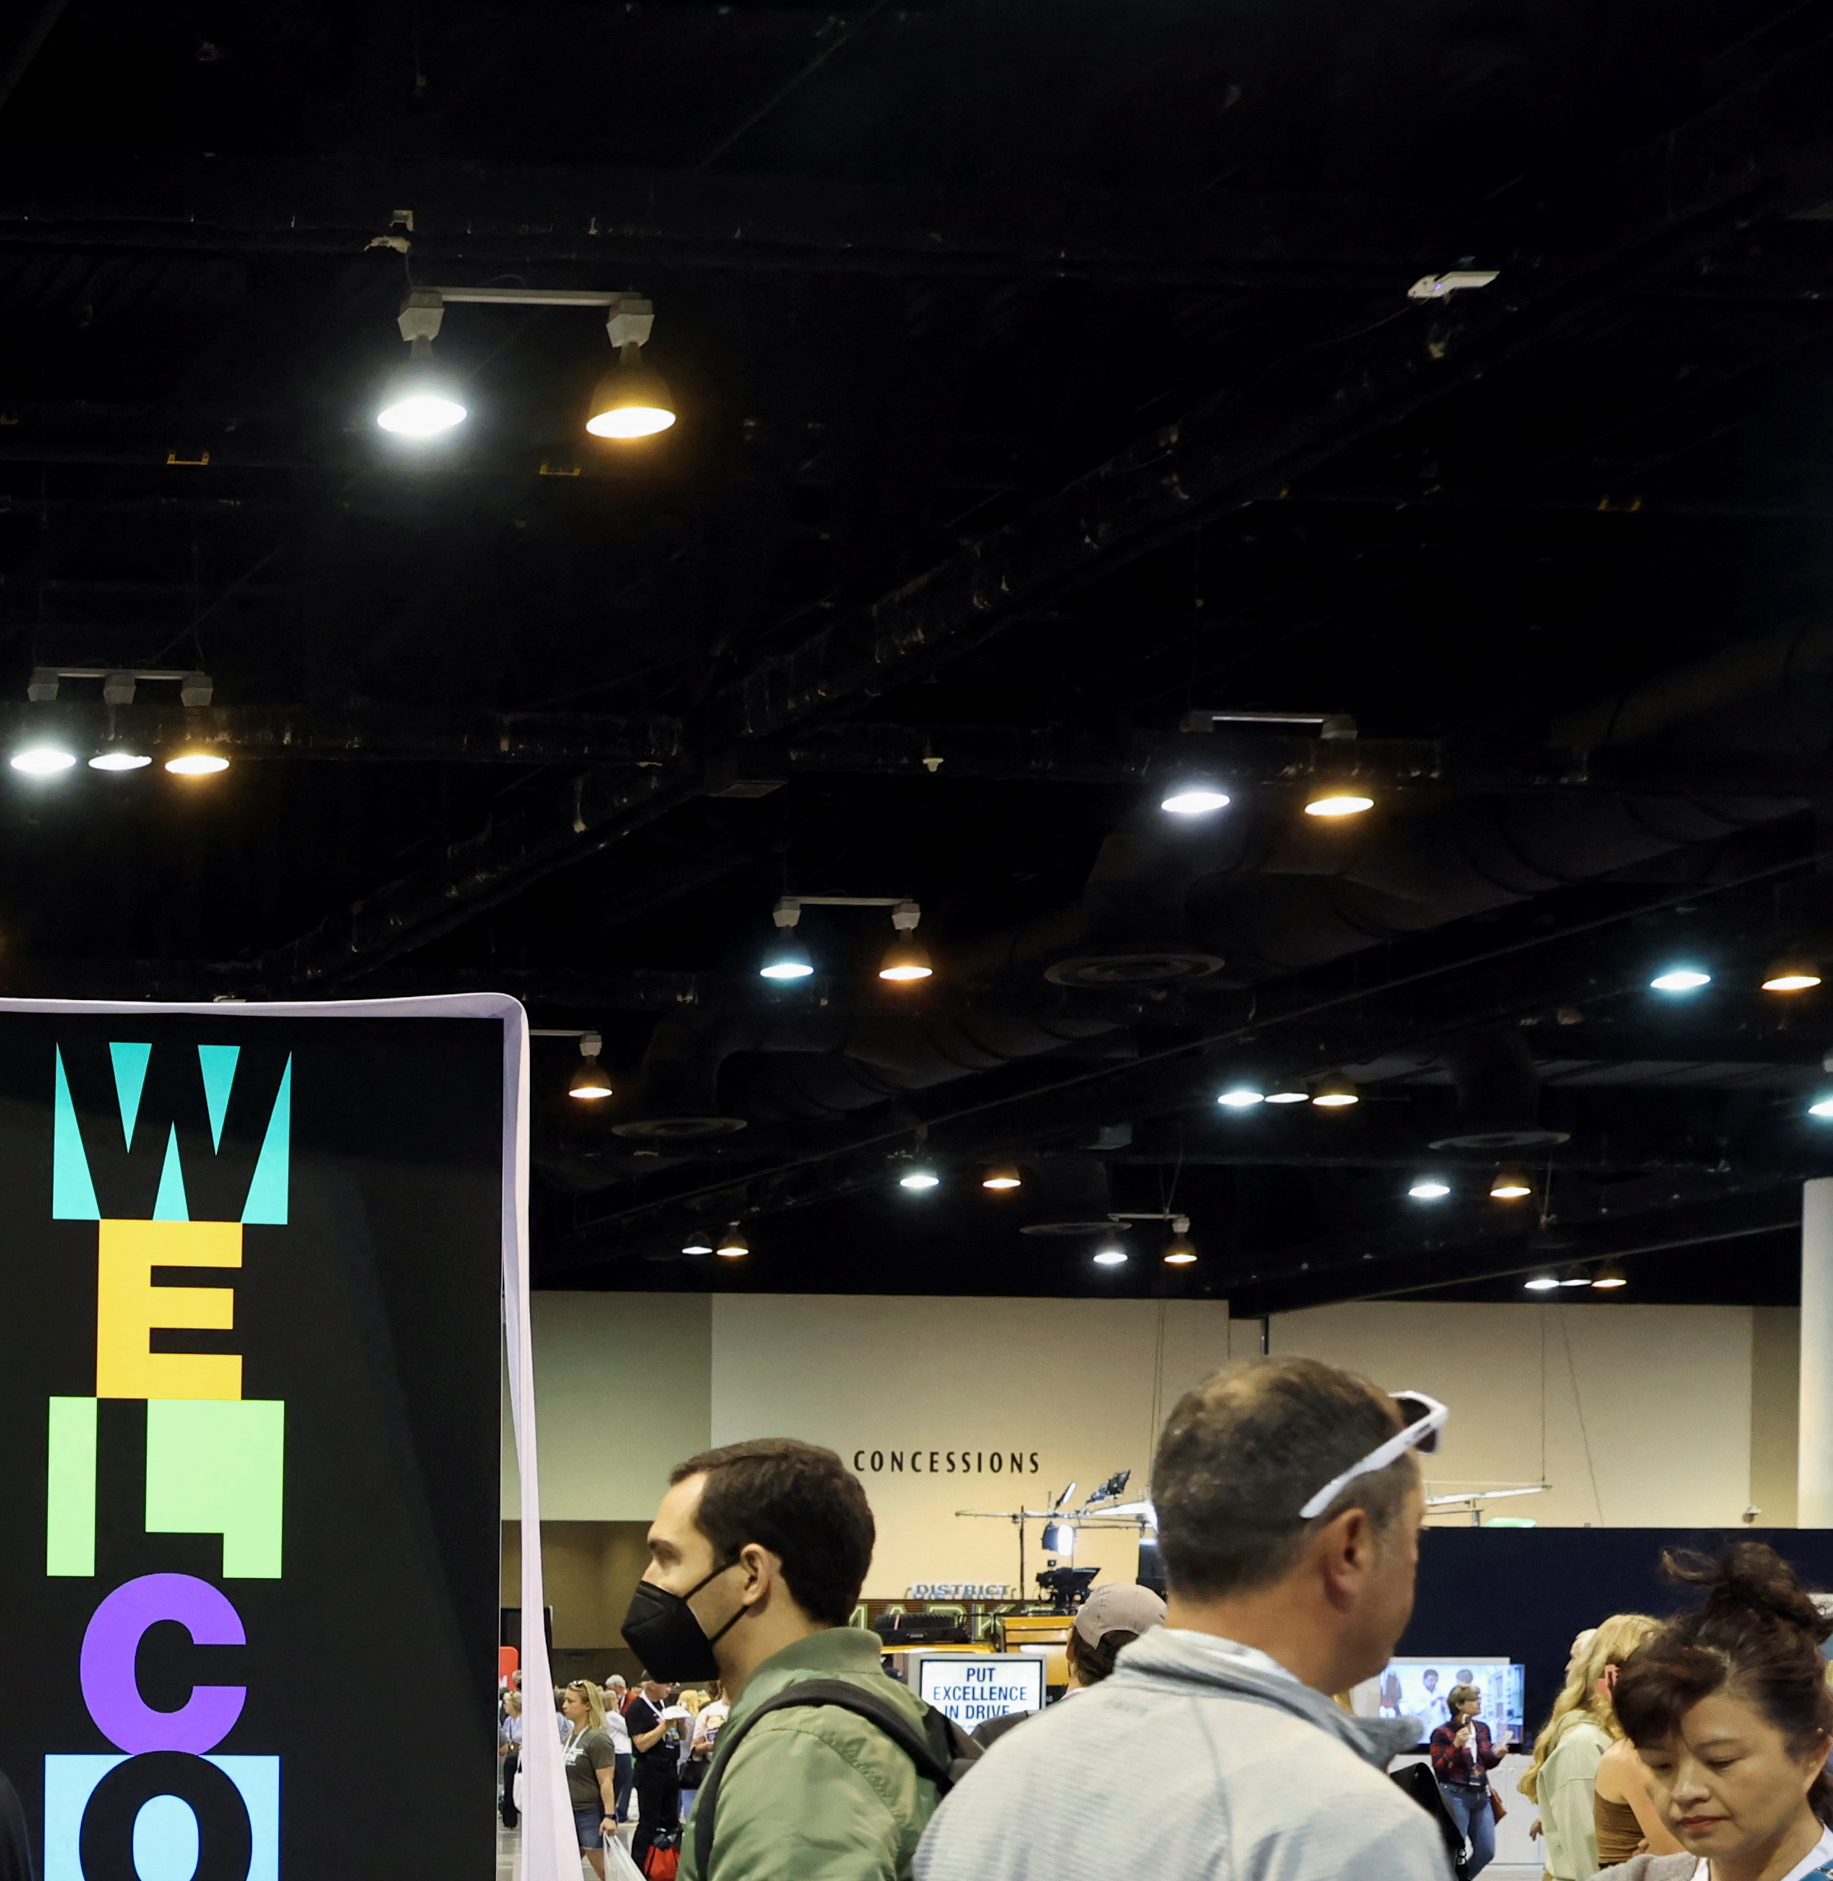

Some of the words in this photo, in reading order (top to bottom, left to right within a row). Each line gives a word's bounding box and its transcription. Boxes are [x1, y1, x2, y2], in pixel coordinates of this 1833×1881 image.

[852, 1449, 1040, 1474] CONCESSIONS
[912, 1583, 1011, 1599] DISTRICT
[966, 1667, 997, 1683] PUT
[933, 1685, 1028, 1701] EXCELLENCE
[944, 1704, 959, 1720] IN
[965, 1704, 1011, 1720] DRIVE
